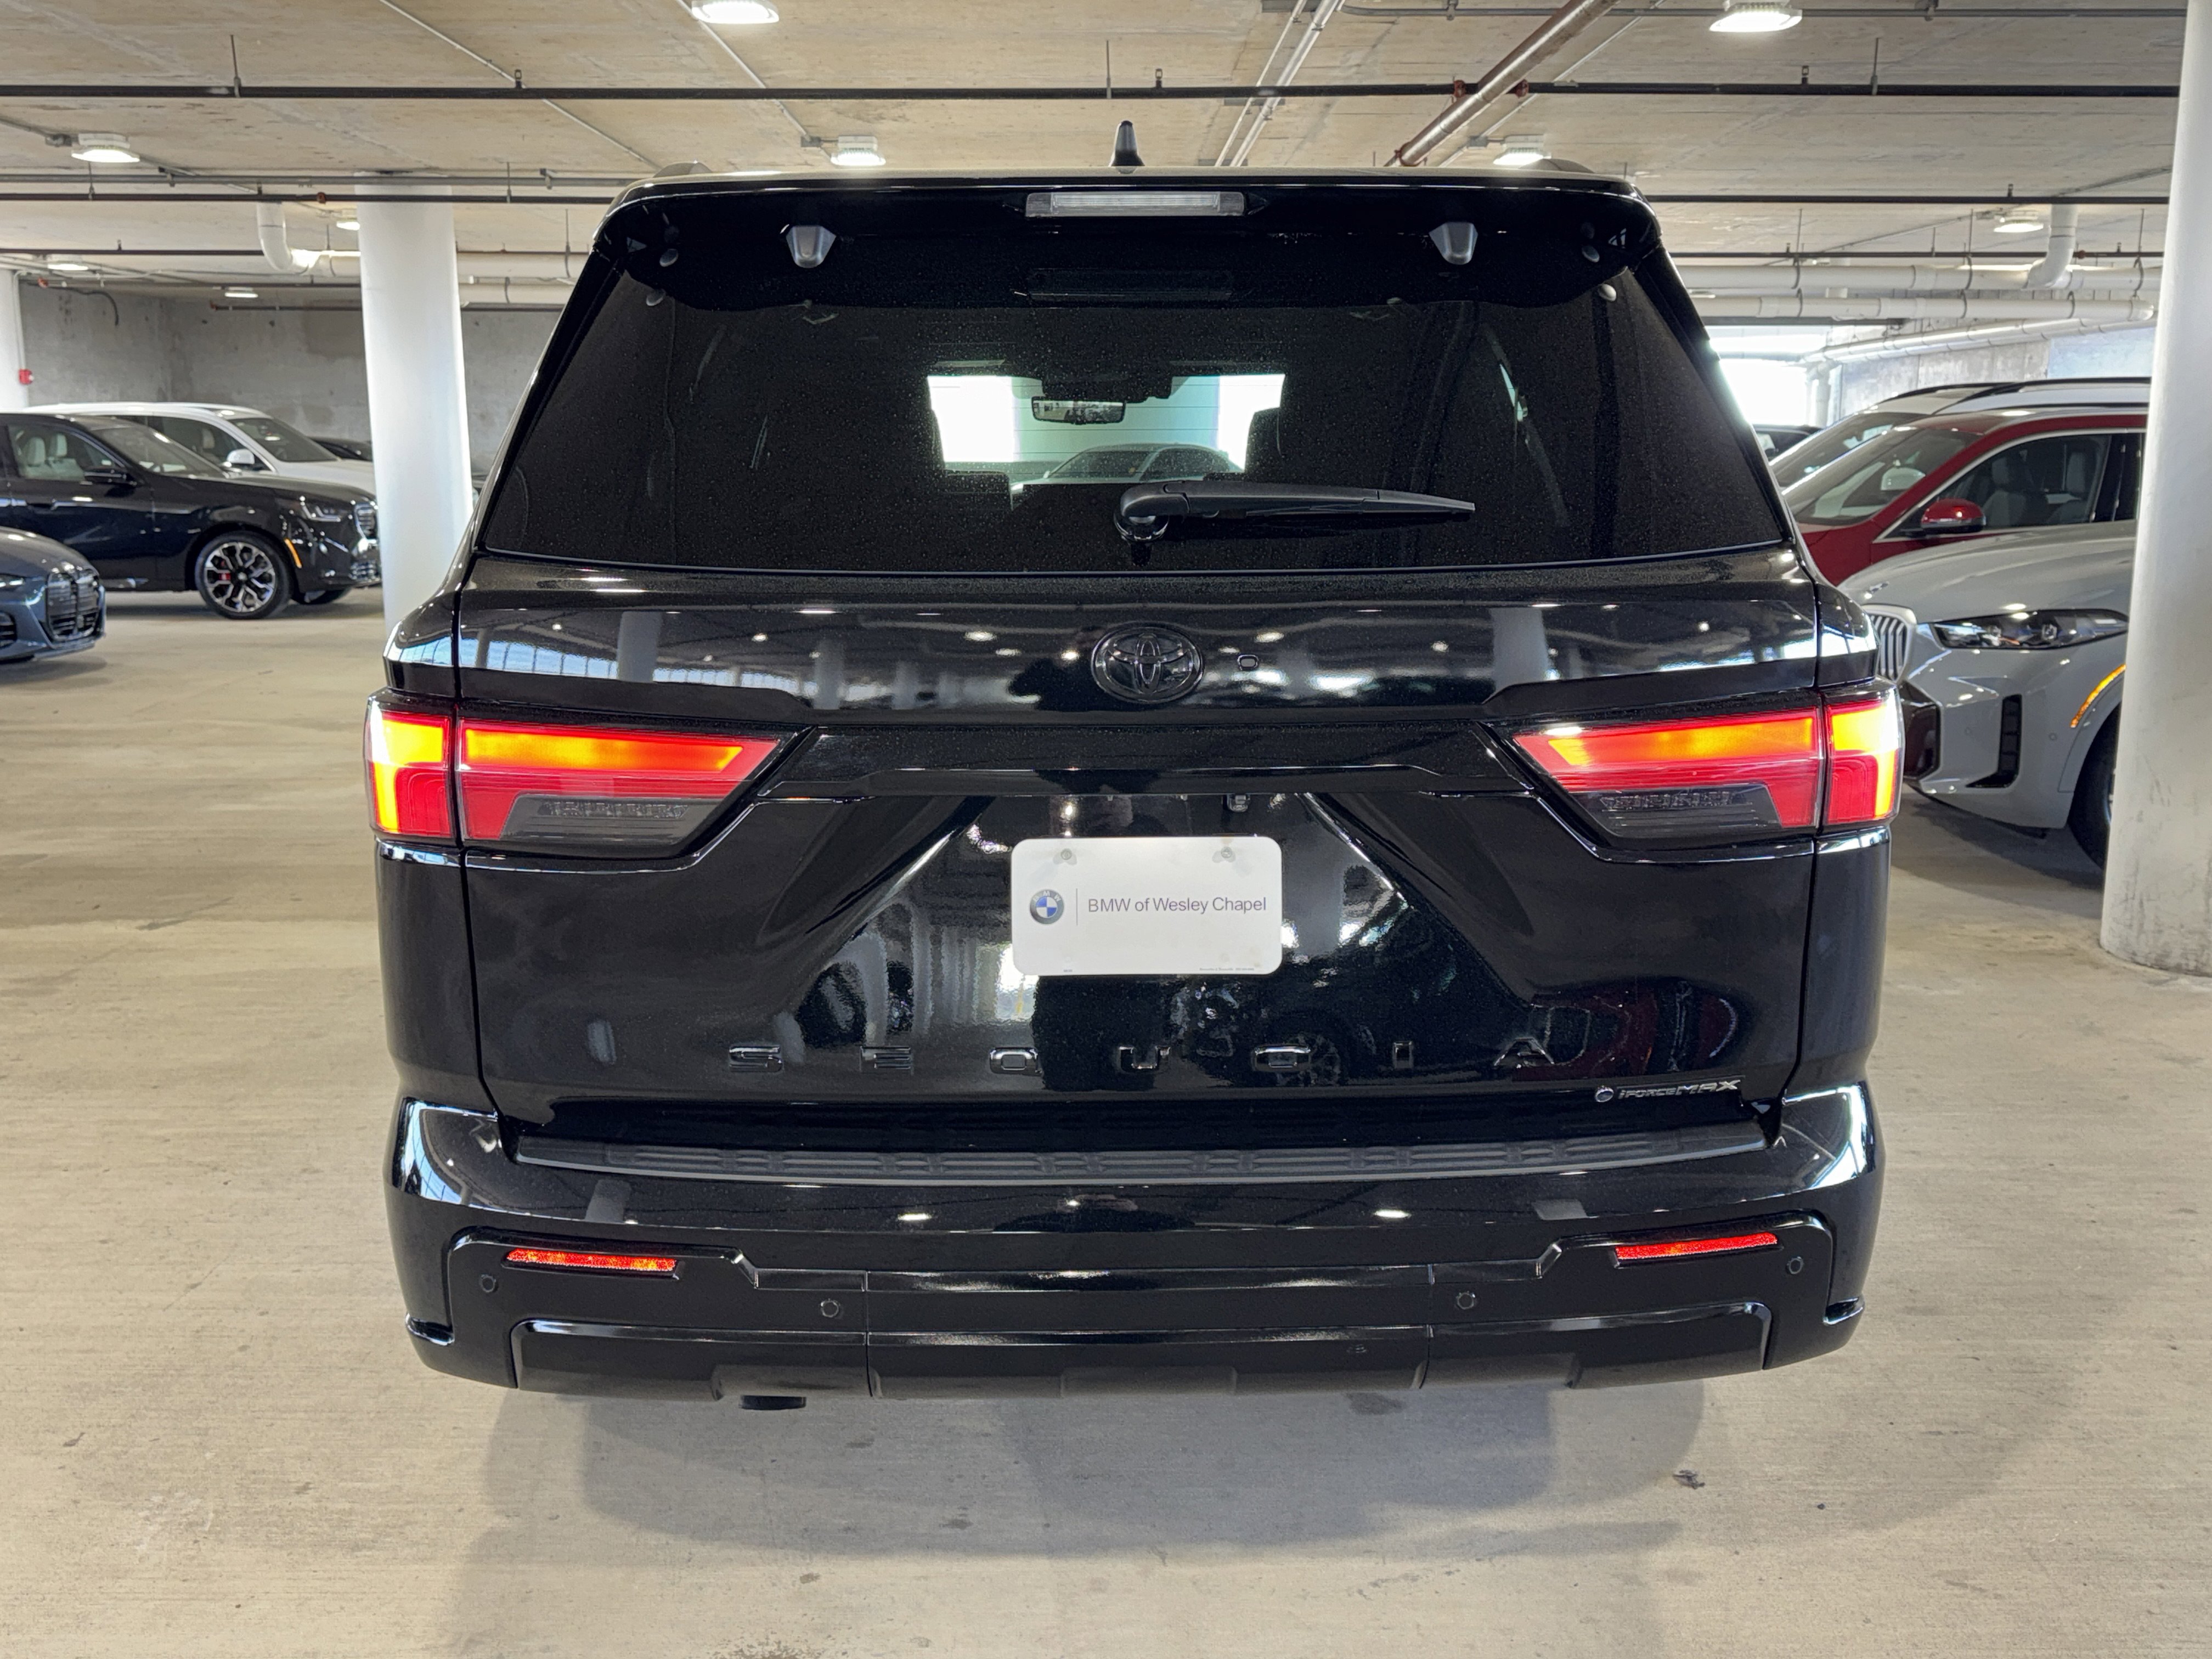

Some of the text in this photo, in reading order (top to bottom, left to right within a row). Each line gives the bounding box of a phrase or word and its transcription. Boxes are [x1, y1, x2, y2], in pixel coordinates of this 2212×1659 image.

[1088, 896, 1266, 914] BMW of Wesley Chapel
[728, 1037, 1555, 1075] SEQUOIA
